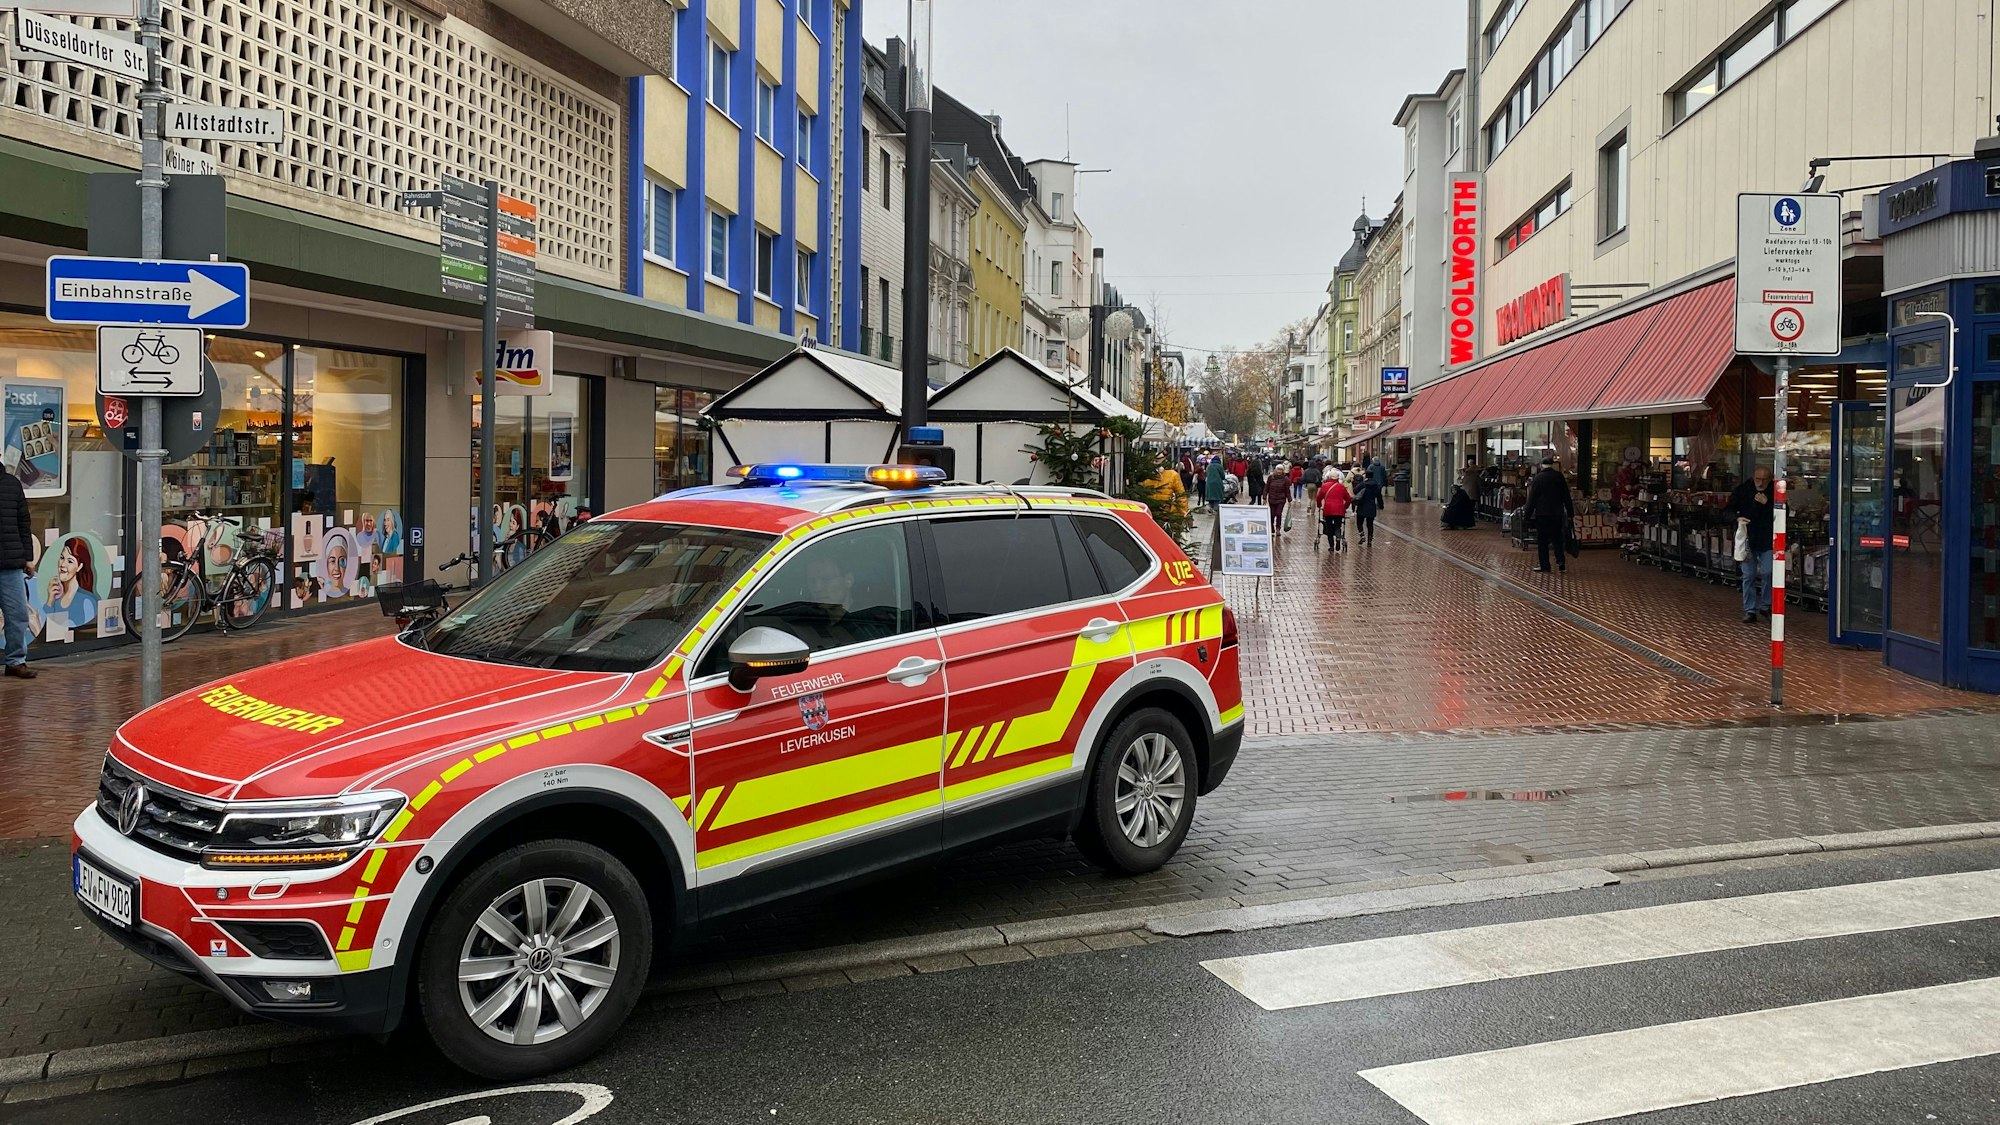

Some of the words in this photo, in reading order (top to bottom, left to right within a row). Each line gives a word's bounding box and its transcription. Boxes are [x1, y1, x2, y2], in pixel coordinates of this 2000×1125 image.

[25, 18, 114, 63] Düsseldorfer
[124, 49, 145, 72] Str.
[174, 111, 276, 136] Altstadtstr.
[165, 149, 195, 174] Kölner
[1887, 178, 1938, 223] TABAK
[1763, 247, 1813, 256] Lieferverkehr
[1450, 181, 1477, 366] WOOLWORTH
[61, 282, 193, 302] Einbahnstraße
[1767, 293, 1809, 301] Feuerwehrzufahrt
[1496, 273, 1565, 346] WOOLWORTH
[496, 340, 534, 369] dm
[1173, 560, 1195, 580] 112
[771, 672, 845, 699] FEUERWEHR
[198, 684, 345, 735] FEUERWEHR
[780, 725, 856, 754] LEVERKUSEN
[543, 779, 556, 787] 140
[556, 777, 569, 785] Nm
[98, 875, 110, 908] FW
[111, 883, 130, 918] 908
